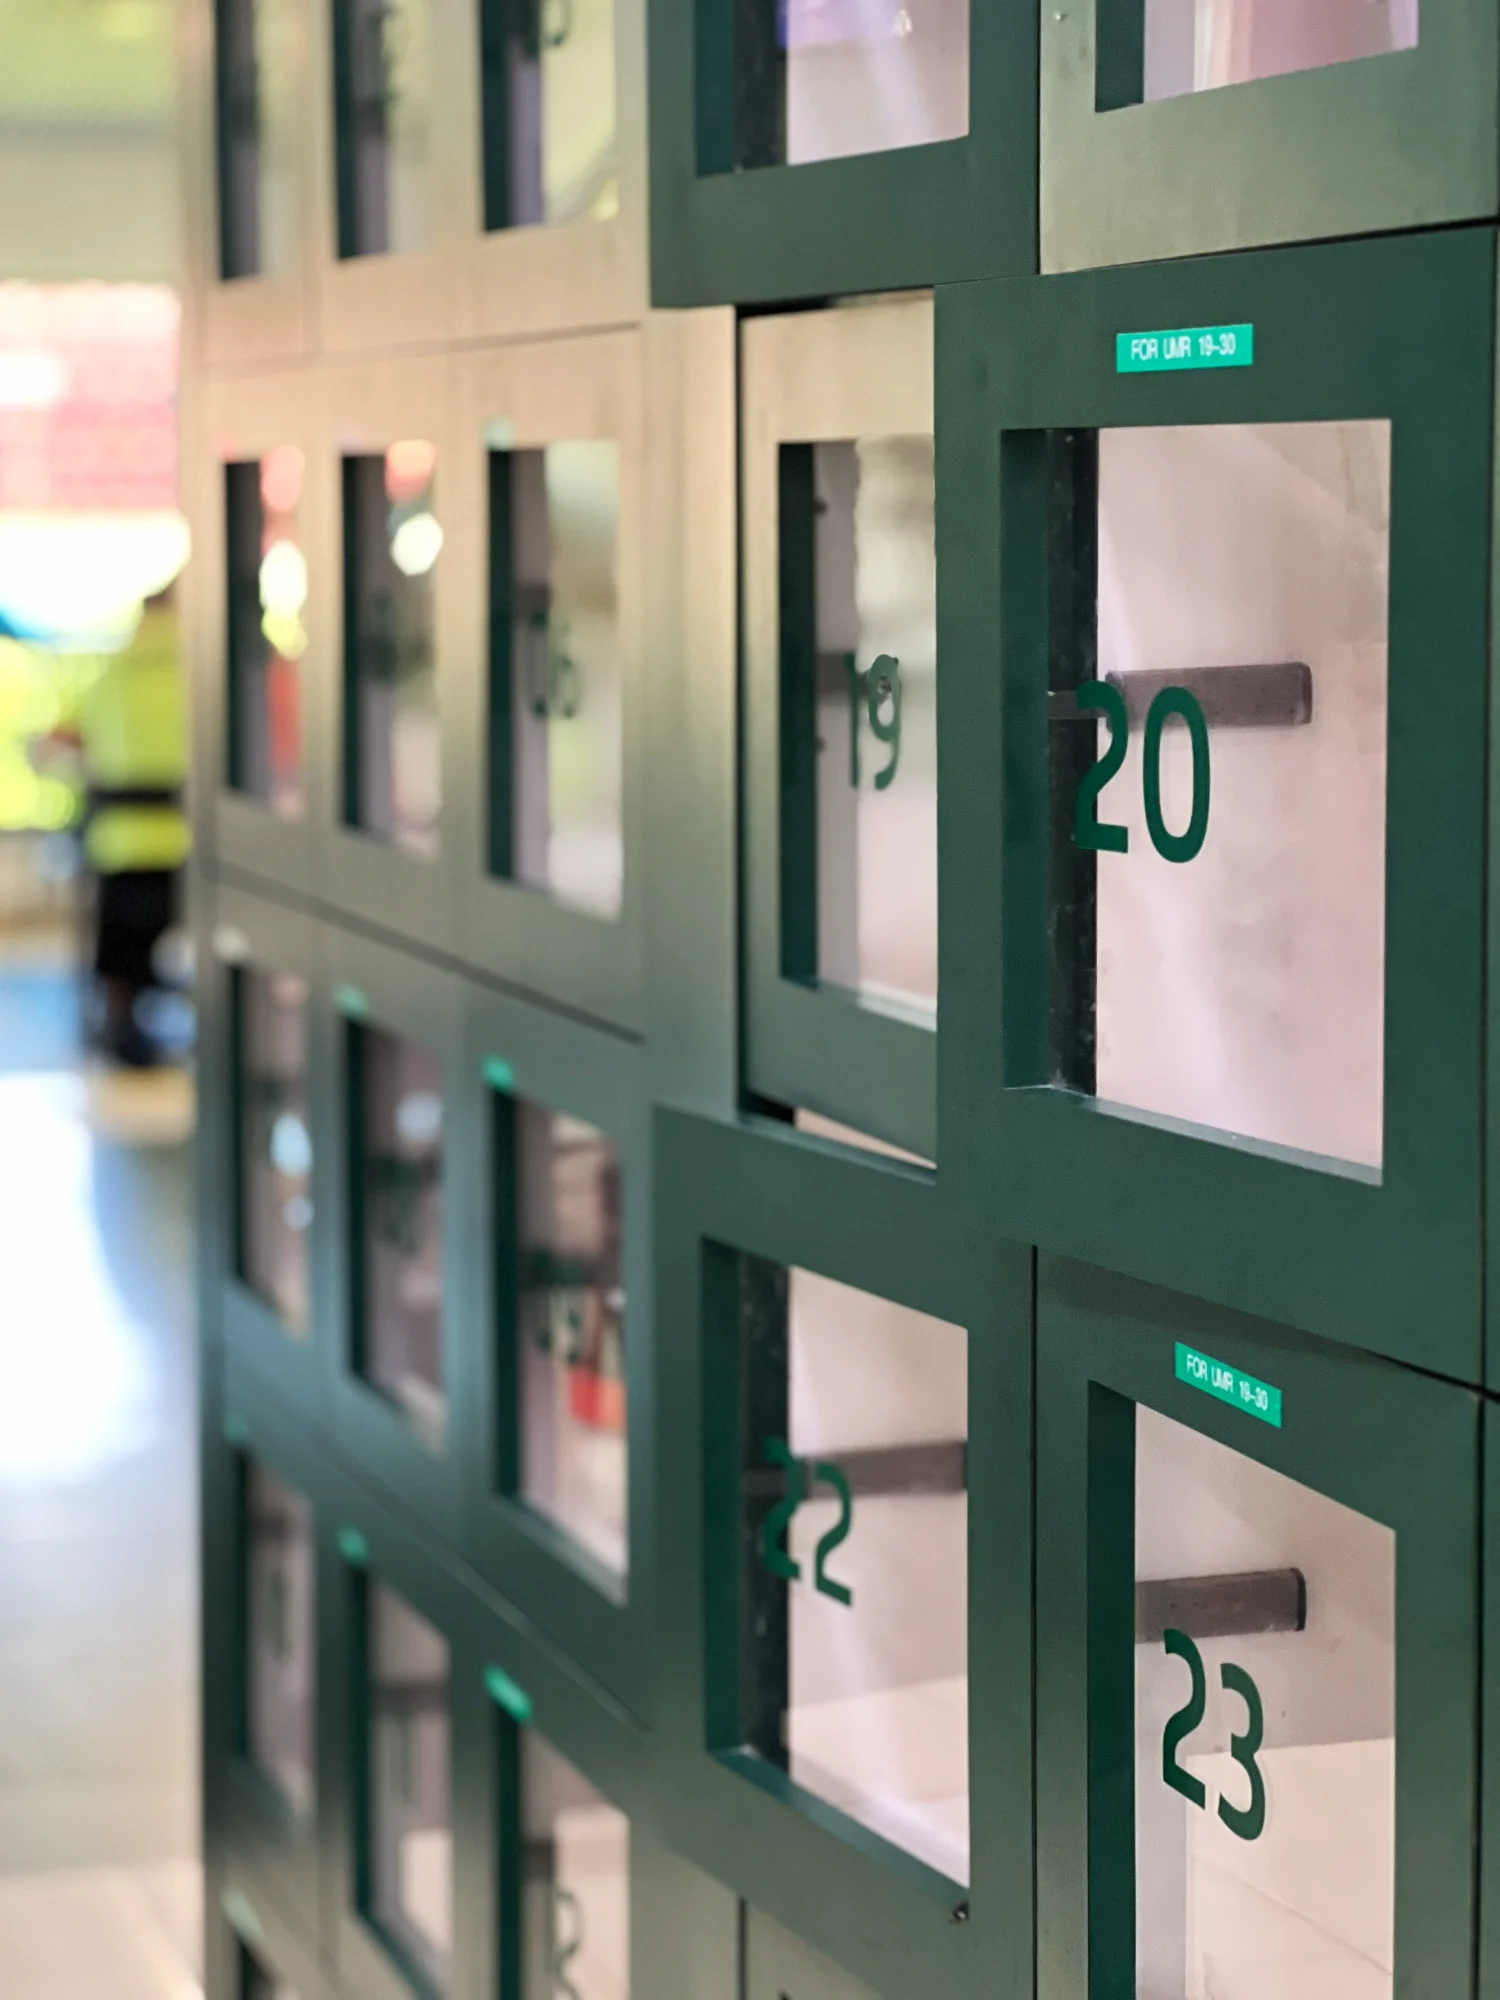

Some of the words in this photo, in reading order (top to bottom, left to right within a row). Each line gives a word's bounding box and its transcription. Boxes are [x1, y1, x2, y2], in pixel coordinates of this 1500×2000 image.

[1131, 337, 1159, 361] FOR
[842, 653, 902, 791] 19
[1074, 679, 1211, 864] 20
[1186, 1353, 1209, 1382] FOR
[763, 1434, 853, 1609] 22
[1162, 1628, 1266, 1841] 23
